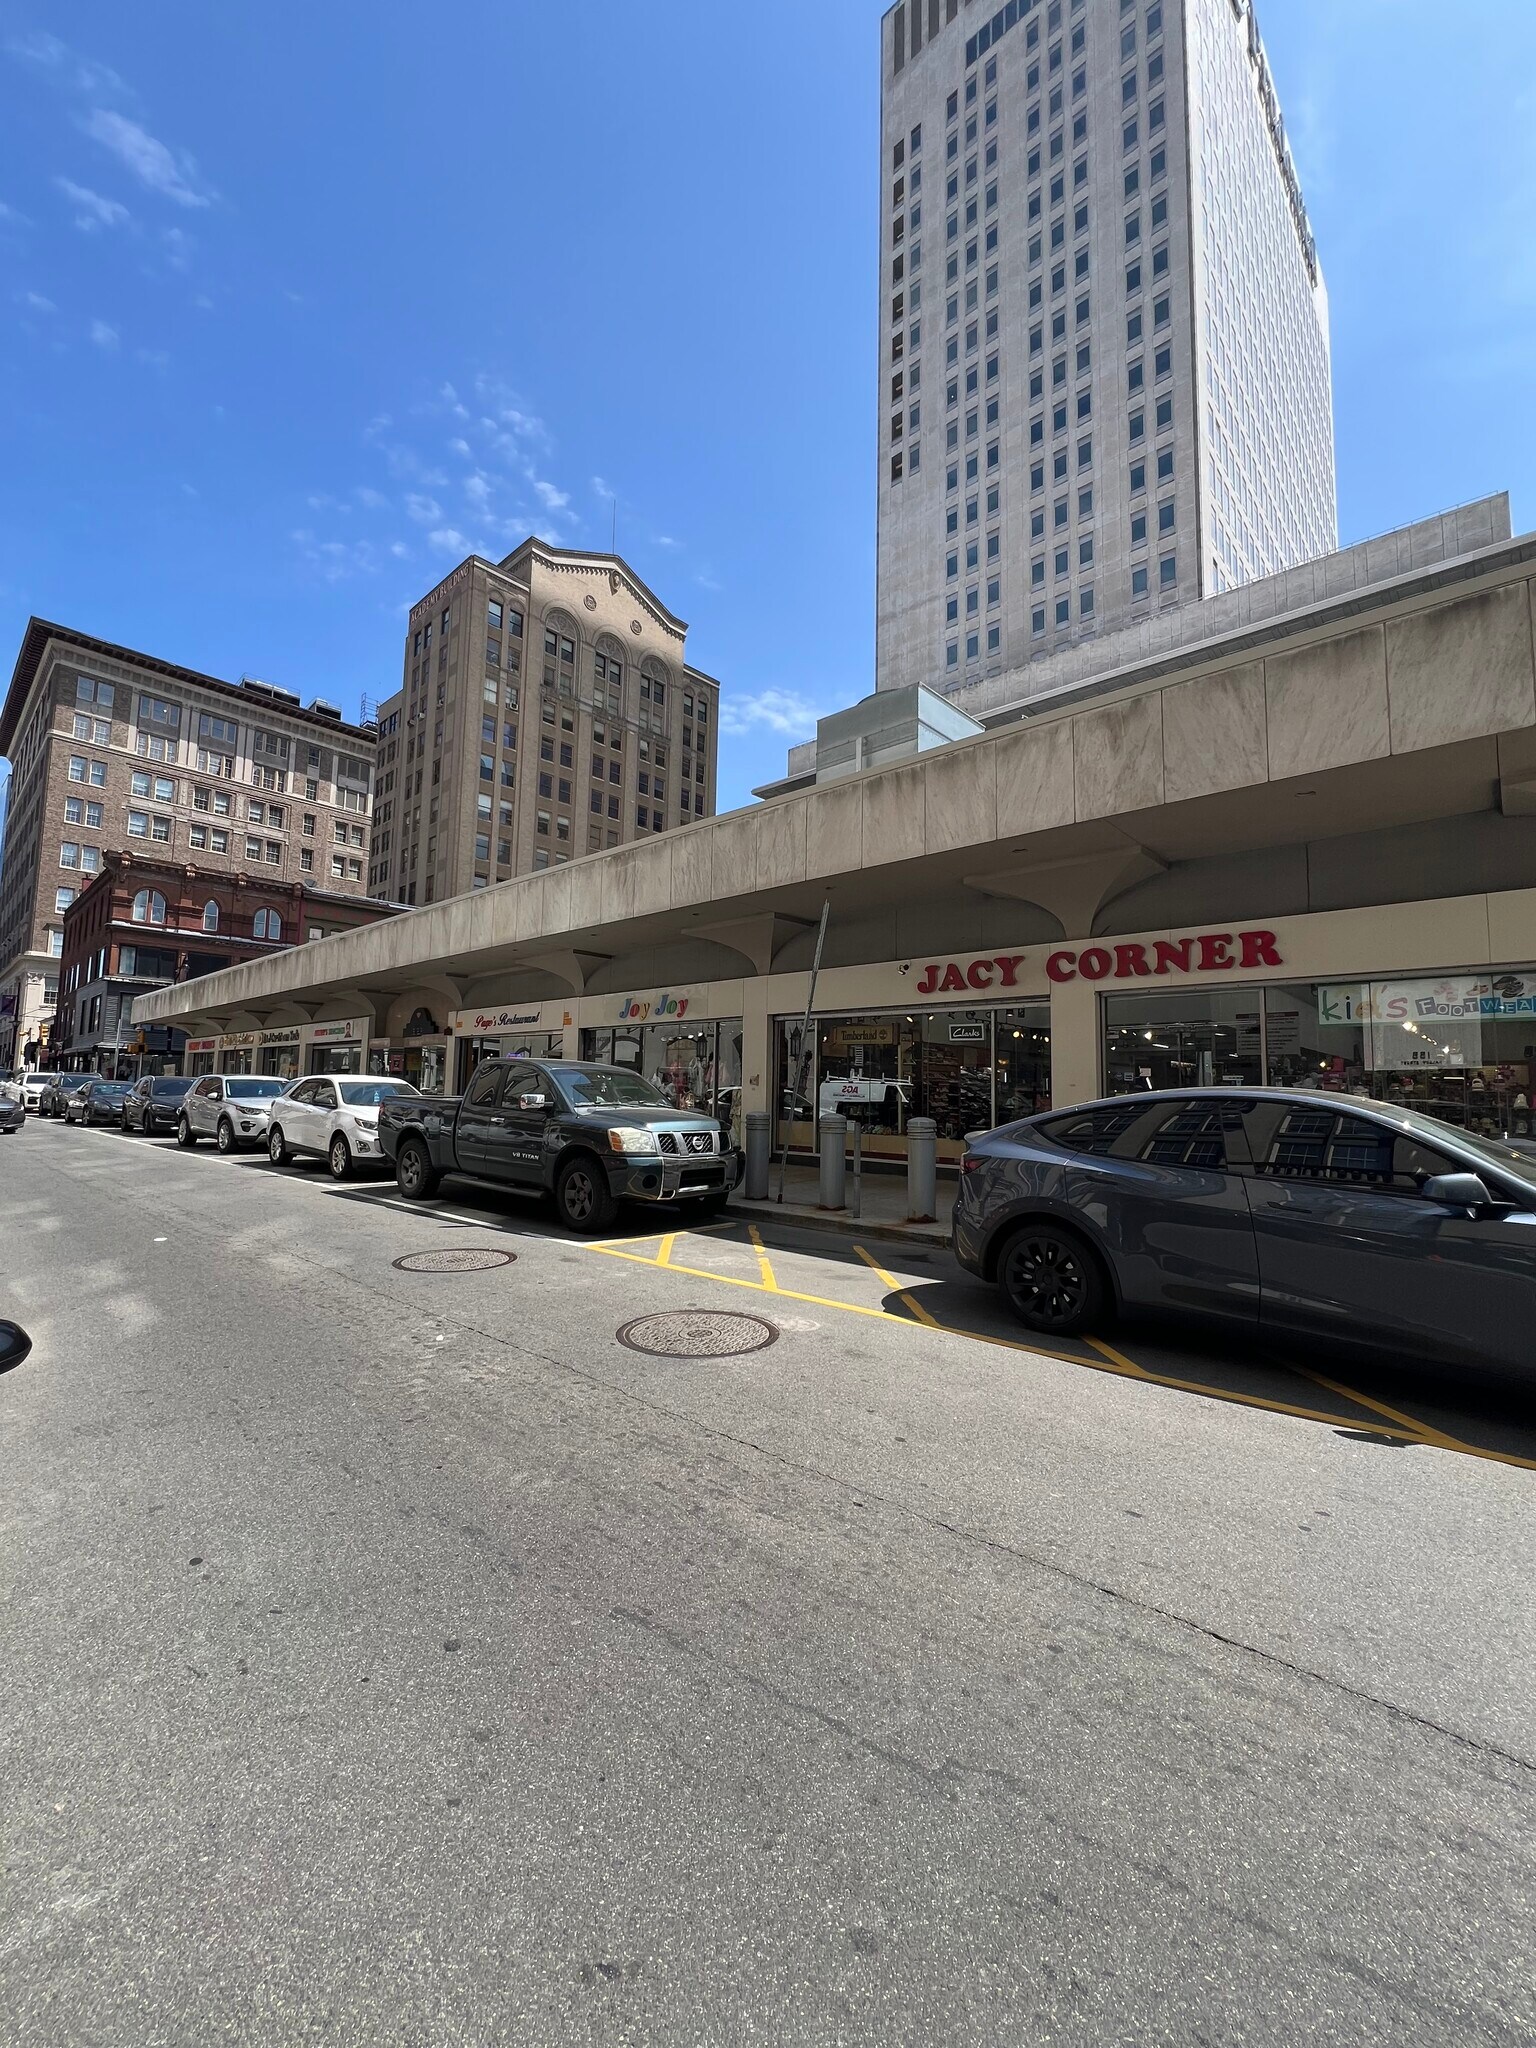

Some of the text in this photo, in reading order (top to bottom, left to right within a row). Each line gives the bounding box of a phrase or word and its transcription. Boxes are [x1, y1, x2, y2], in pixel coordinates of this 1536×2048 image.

[411, 564, 470, 622] ACADEMY BUILDING
[917, 930, 1284, 994] JACY CORNER
[619, 993, 689, 1022] Joy Joy
[1416, 997, 1536, 1017] FOOTWEA
[474, 1011, 541, 1030] Page's Restaurant
[841, 1029, 878, 1041] Timberland
[952, 1028, 980, 1038] Clarks
[522, 1152, 540, 1160] TITAN
